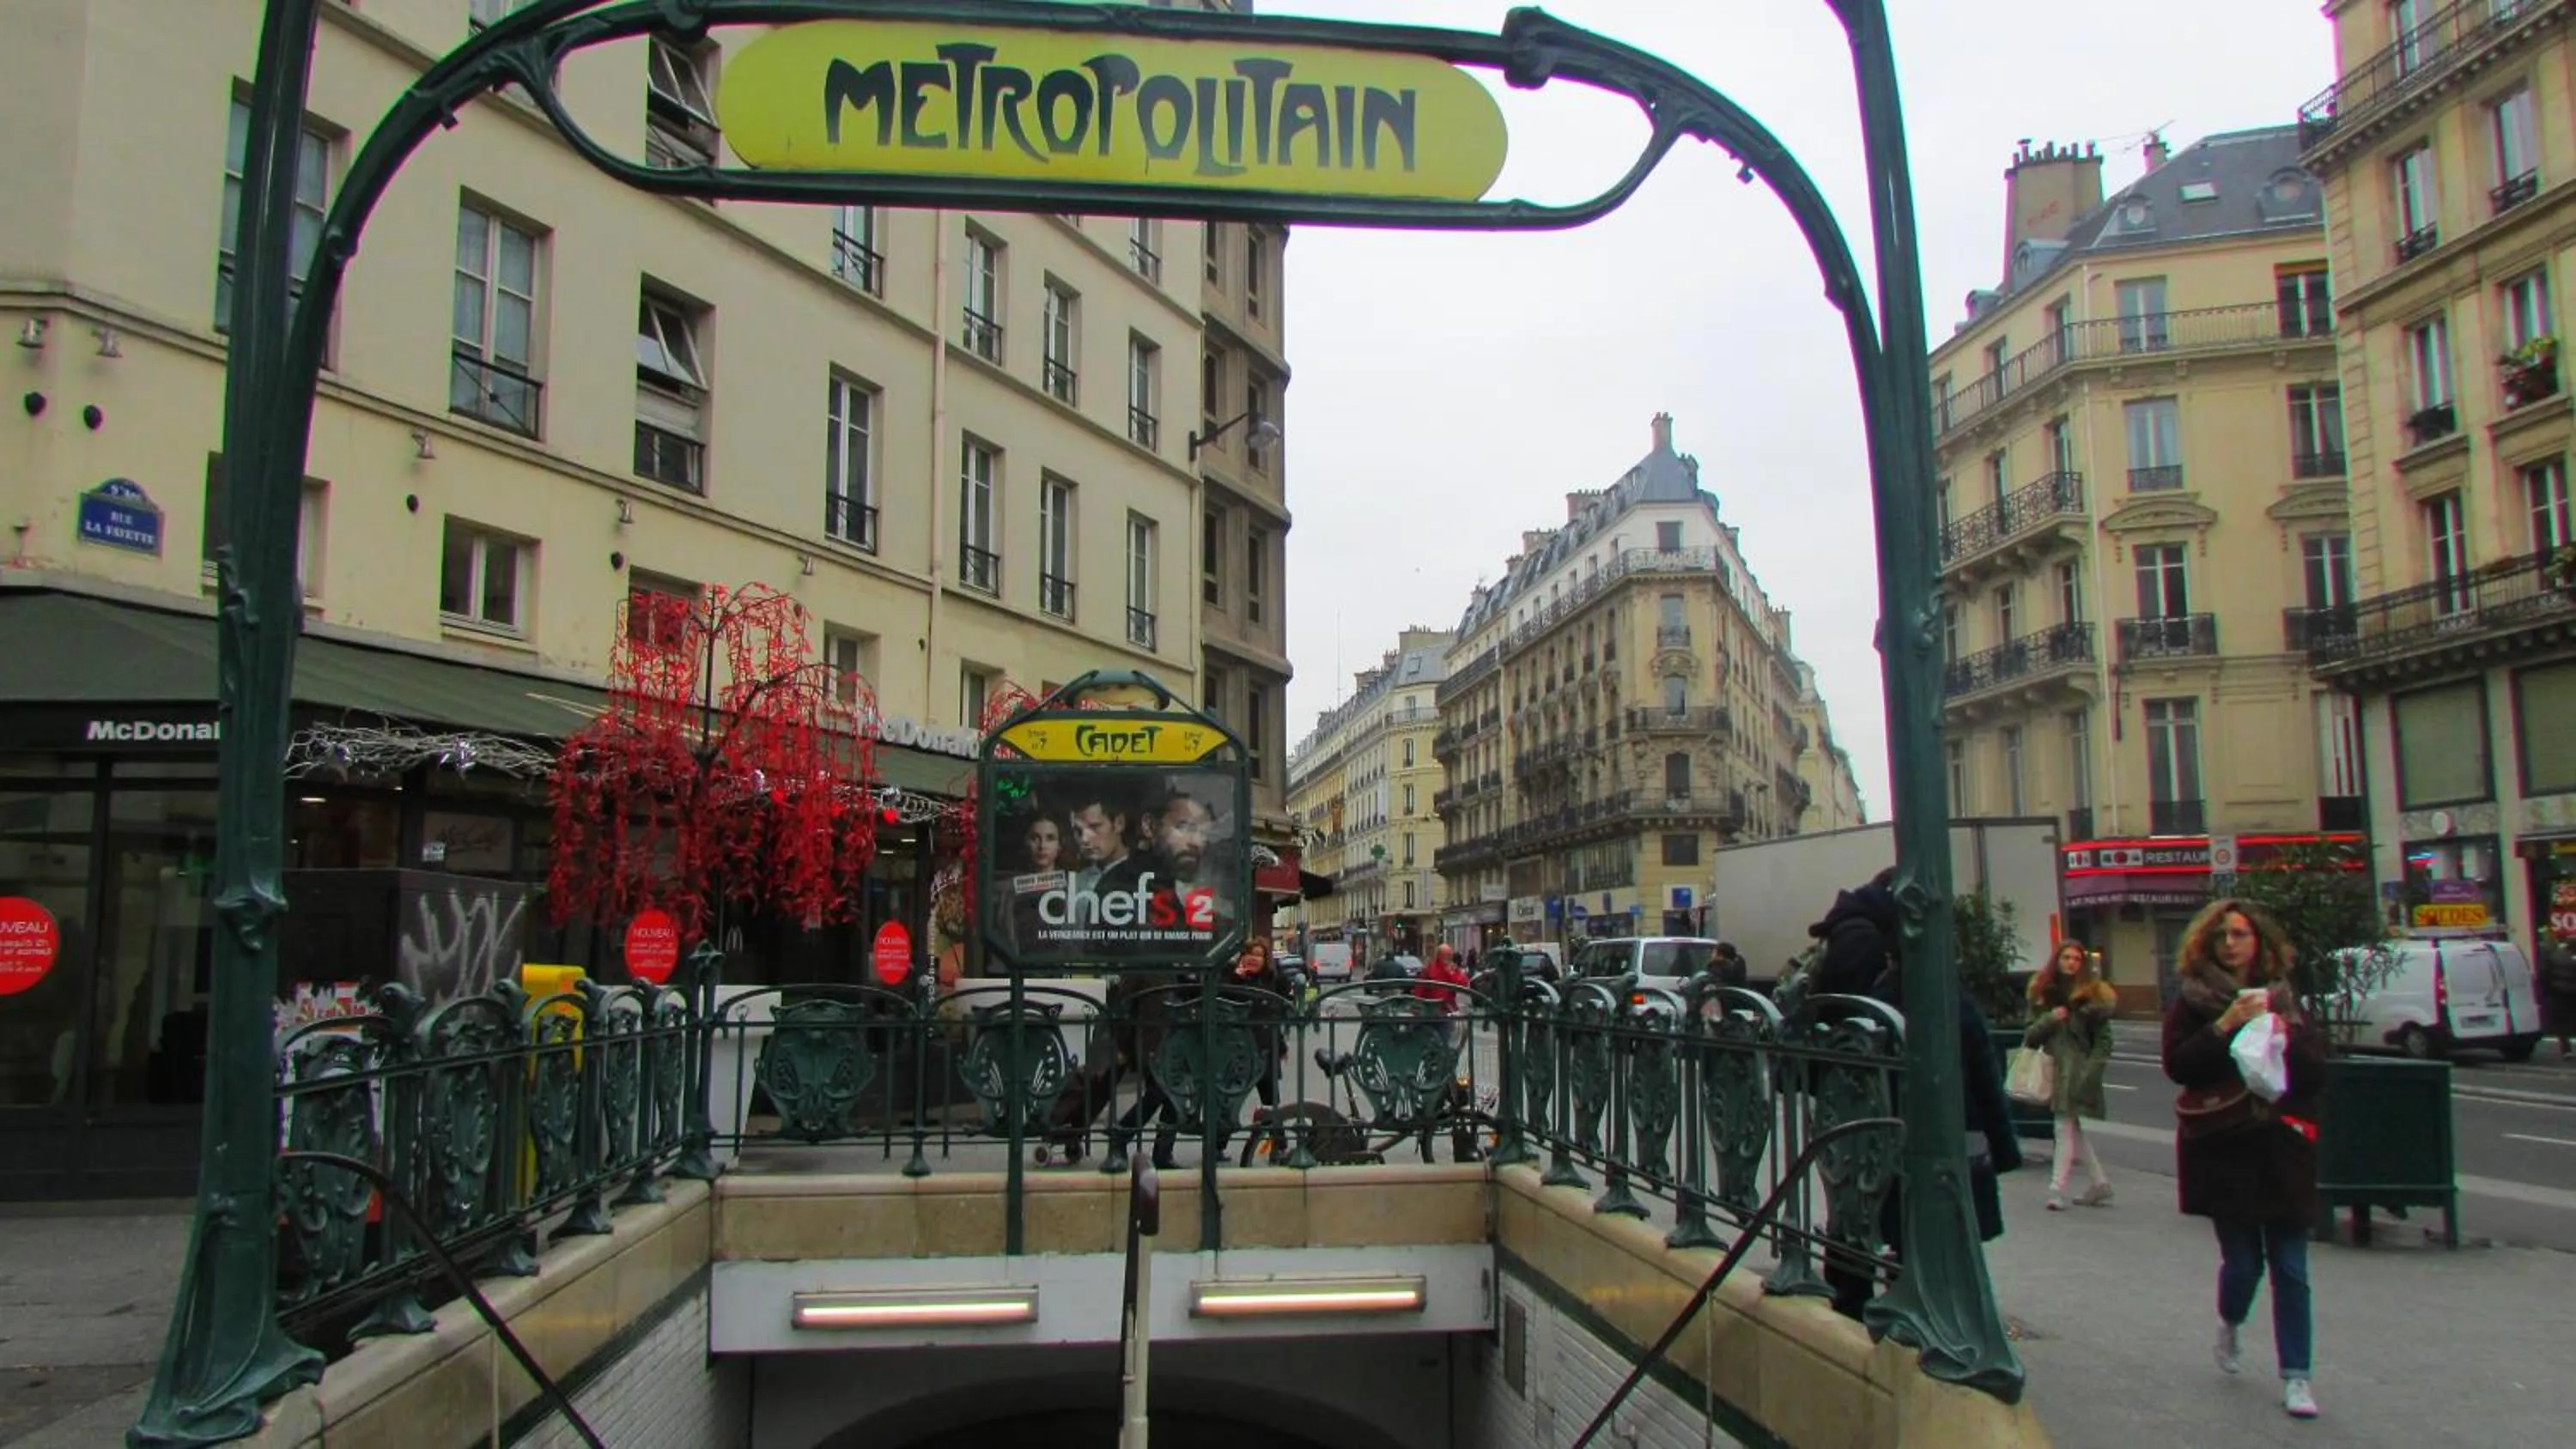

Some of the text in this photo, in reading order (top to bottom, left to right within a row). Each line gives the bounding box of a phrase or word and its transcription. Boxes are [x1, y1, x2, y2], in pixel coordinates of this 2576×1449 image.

[823, 42, 1416, 174] METROPOLITAIN
[85, 519, 101, 533] LA
[87, 720, 221, 740] McDonal
[1075, 724, 1163, 756] CADET
[2146, 850, 2208, 864] RESTAU
[1038, 871, 1176, 927] chefs
[0, 921, 49, 934] UVEAU
